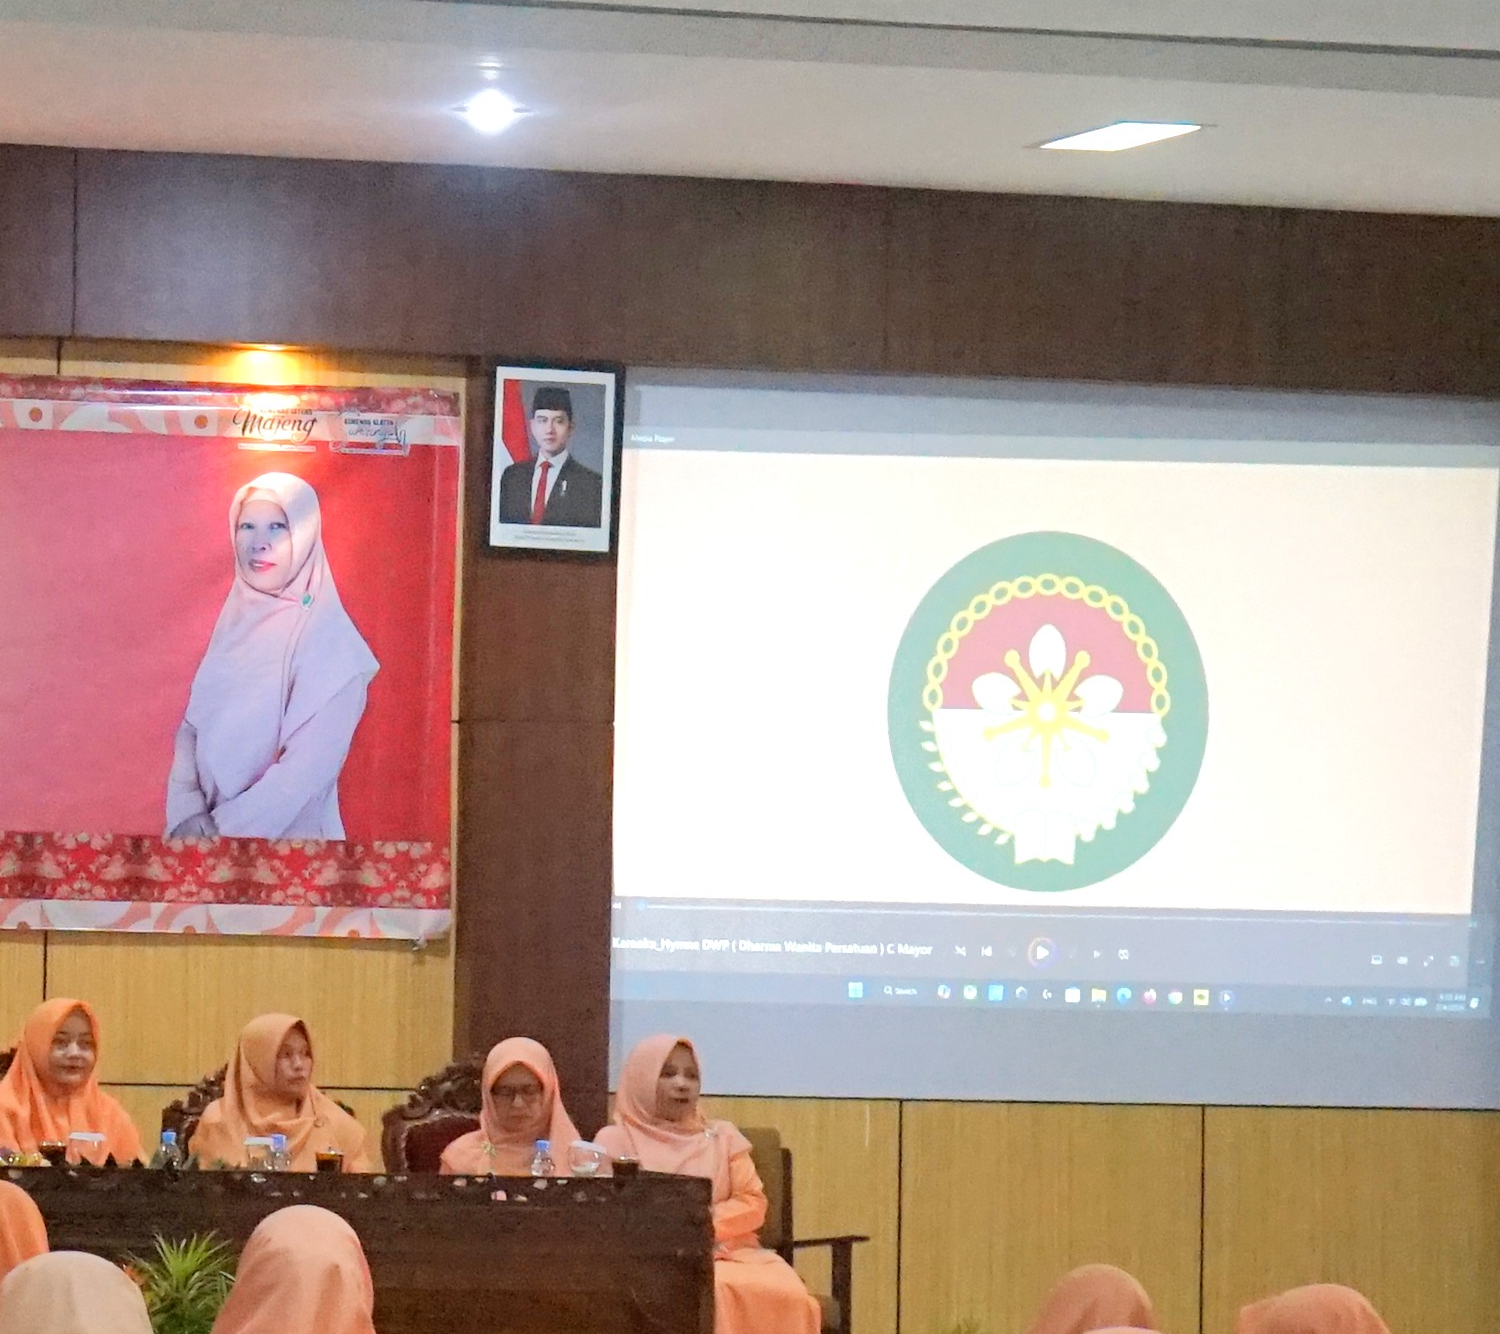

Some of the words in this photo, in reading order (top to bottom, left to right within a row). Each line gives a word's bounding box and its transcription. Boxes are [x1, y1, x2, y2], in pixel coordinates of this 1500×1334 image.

[701, 938, 731, 952] DWP
[738, 939, 782, 953] Dharma
[784, 940, 823, 954] Wanita
[897, 943, 934, 958] Mayor
